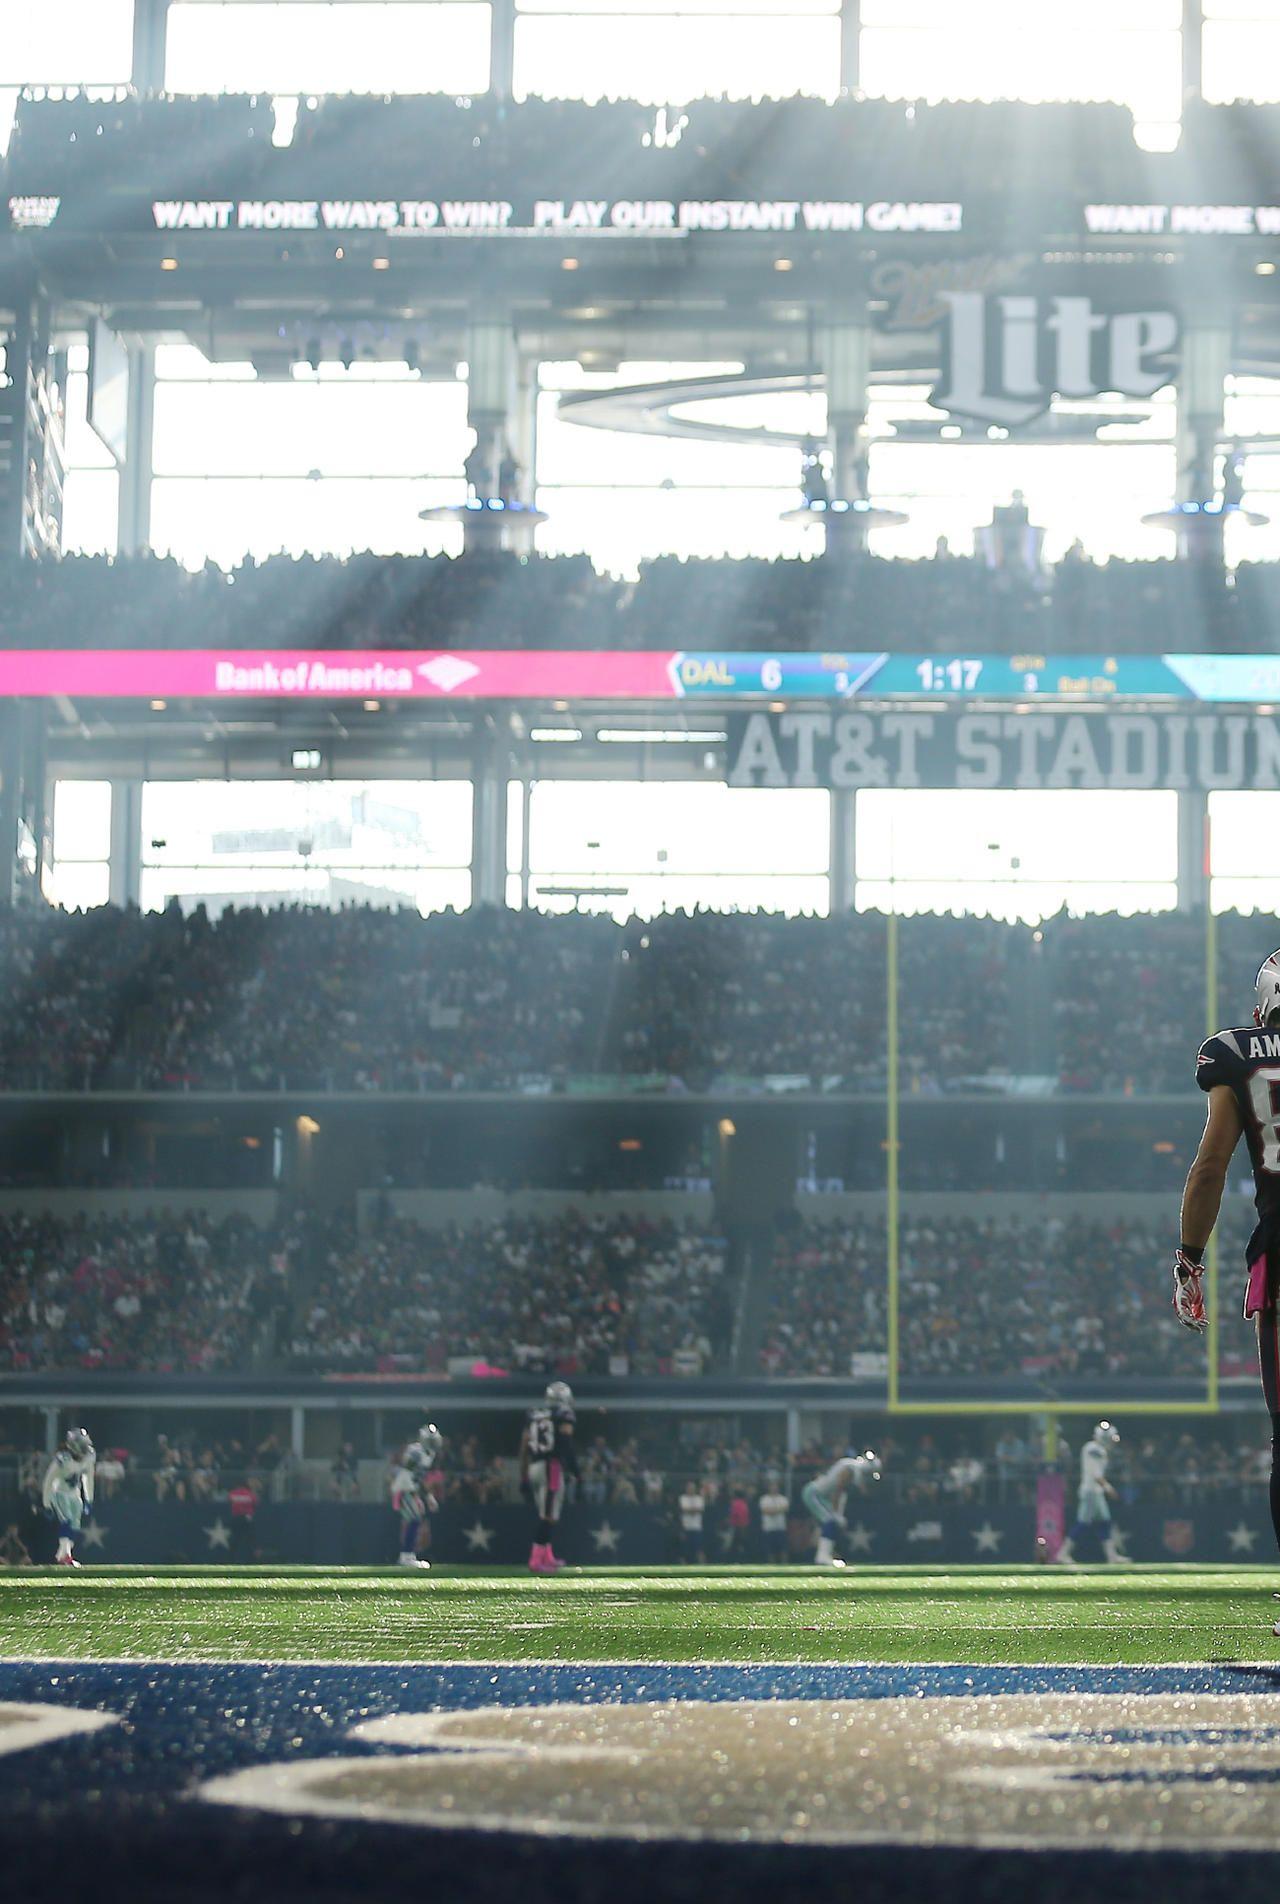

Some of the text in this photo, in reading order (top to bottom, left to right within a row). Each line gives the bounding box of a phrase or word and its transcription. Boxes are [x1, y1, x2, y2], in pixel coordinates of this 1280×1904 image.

[152, 201, 513, 228] WANT MORE WAYS TO WIN?
[534, 202, 607, 228] PLAY
[611, 202, 675, 228] OUR
[679, 202, 799, 230] INSTANT
[803, 203, 863, 230] WIN
[1085, 205, 1167, 232] WANT
[1171, 206, 1254, 233] MORE
[933, 290, 1178, 424] Lite
[216, 661, 413, 690] Bank of America
[682, 658, 782, 691] DAL 6
[917, 658, 983, 690] 1:17
[730, 715, 933, 788] AT&T
